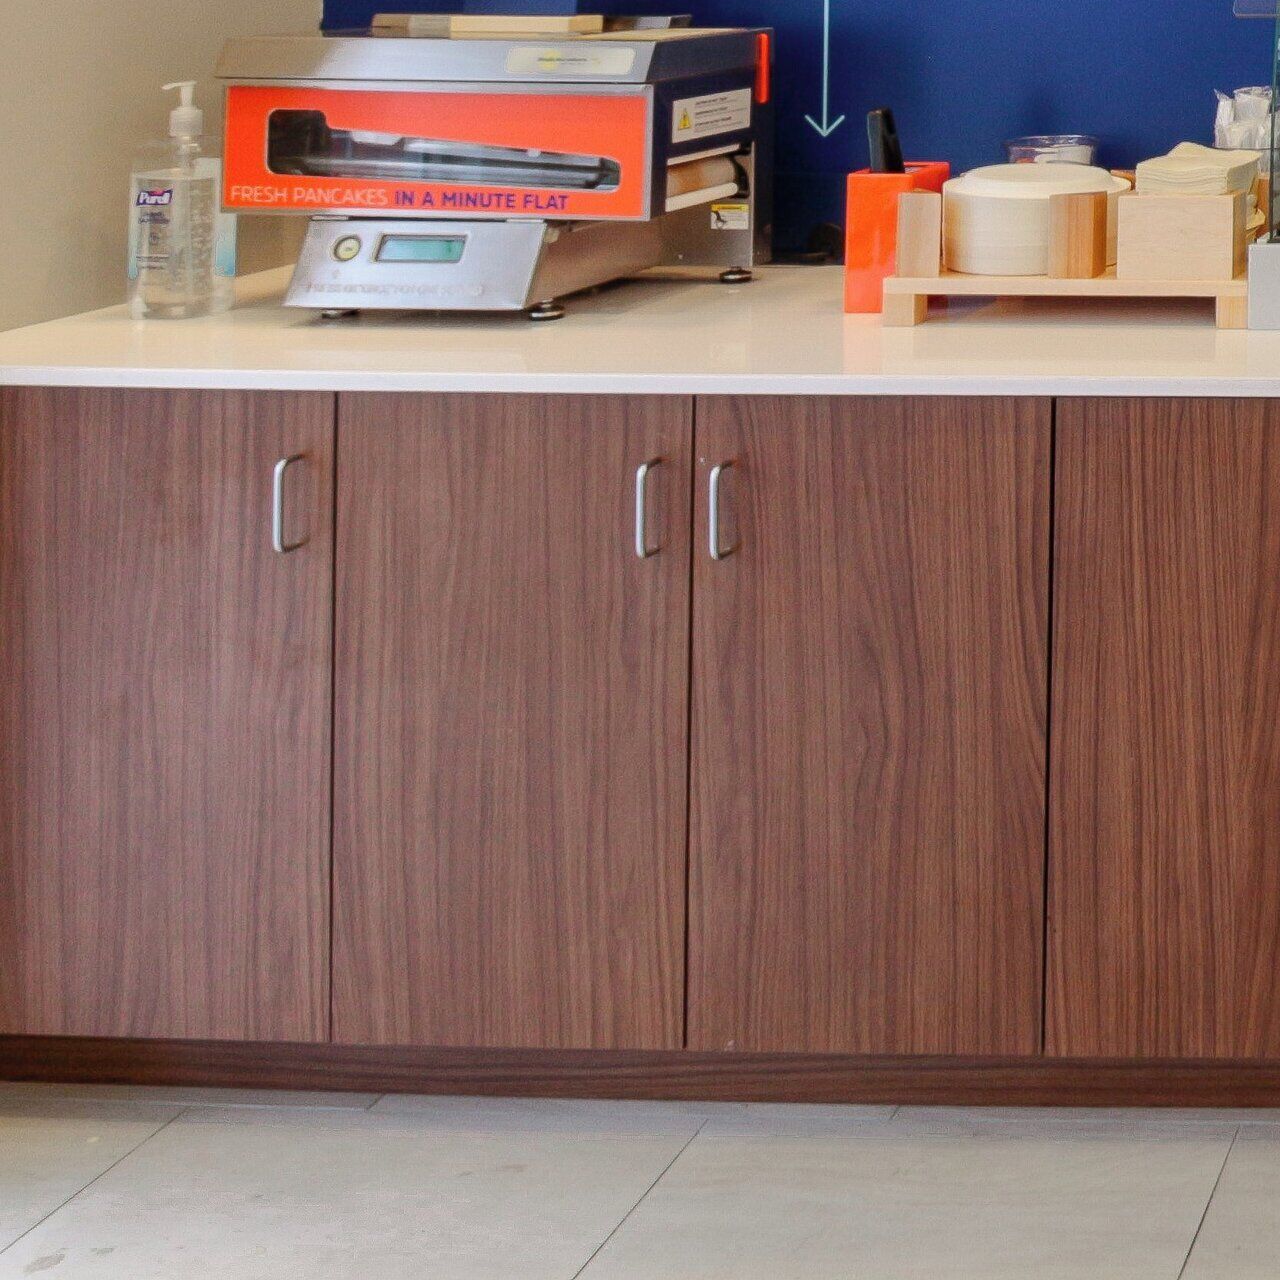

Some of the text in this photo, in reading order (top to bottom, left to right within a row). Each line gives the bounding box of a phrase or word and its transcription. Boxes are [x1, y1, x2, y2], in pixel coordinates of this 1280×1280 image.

[229, 184, 570, 211] FRESH PANCAKES IN A MINUTE FLAT
